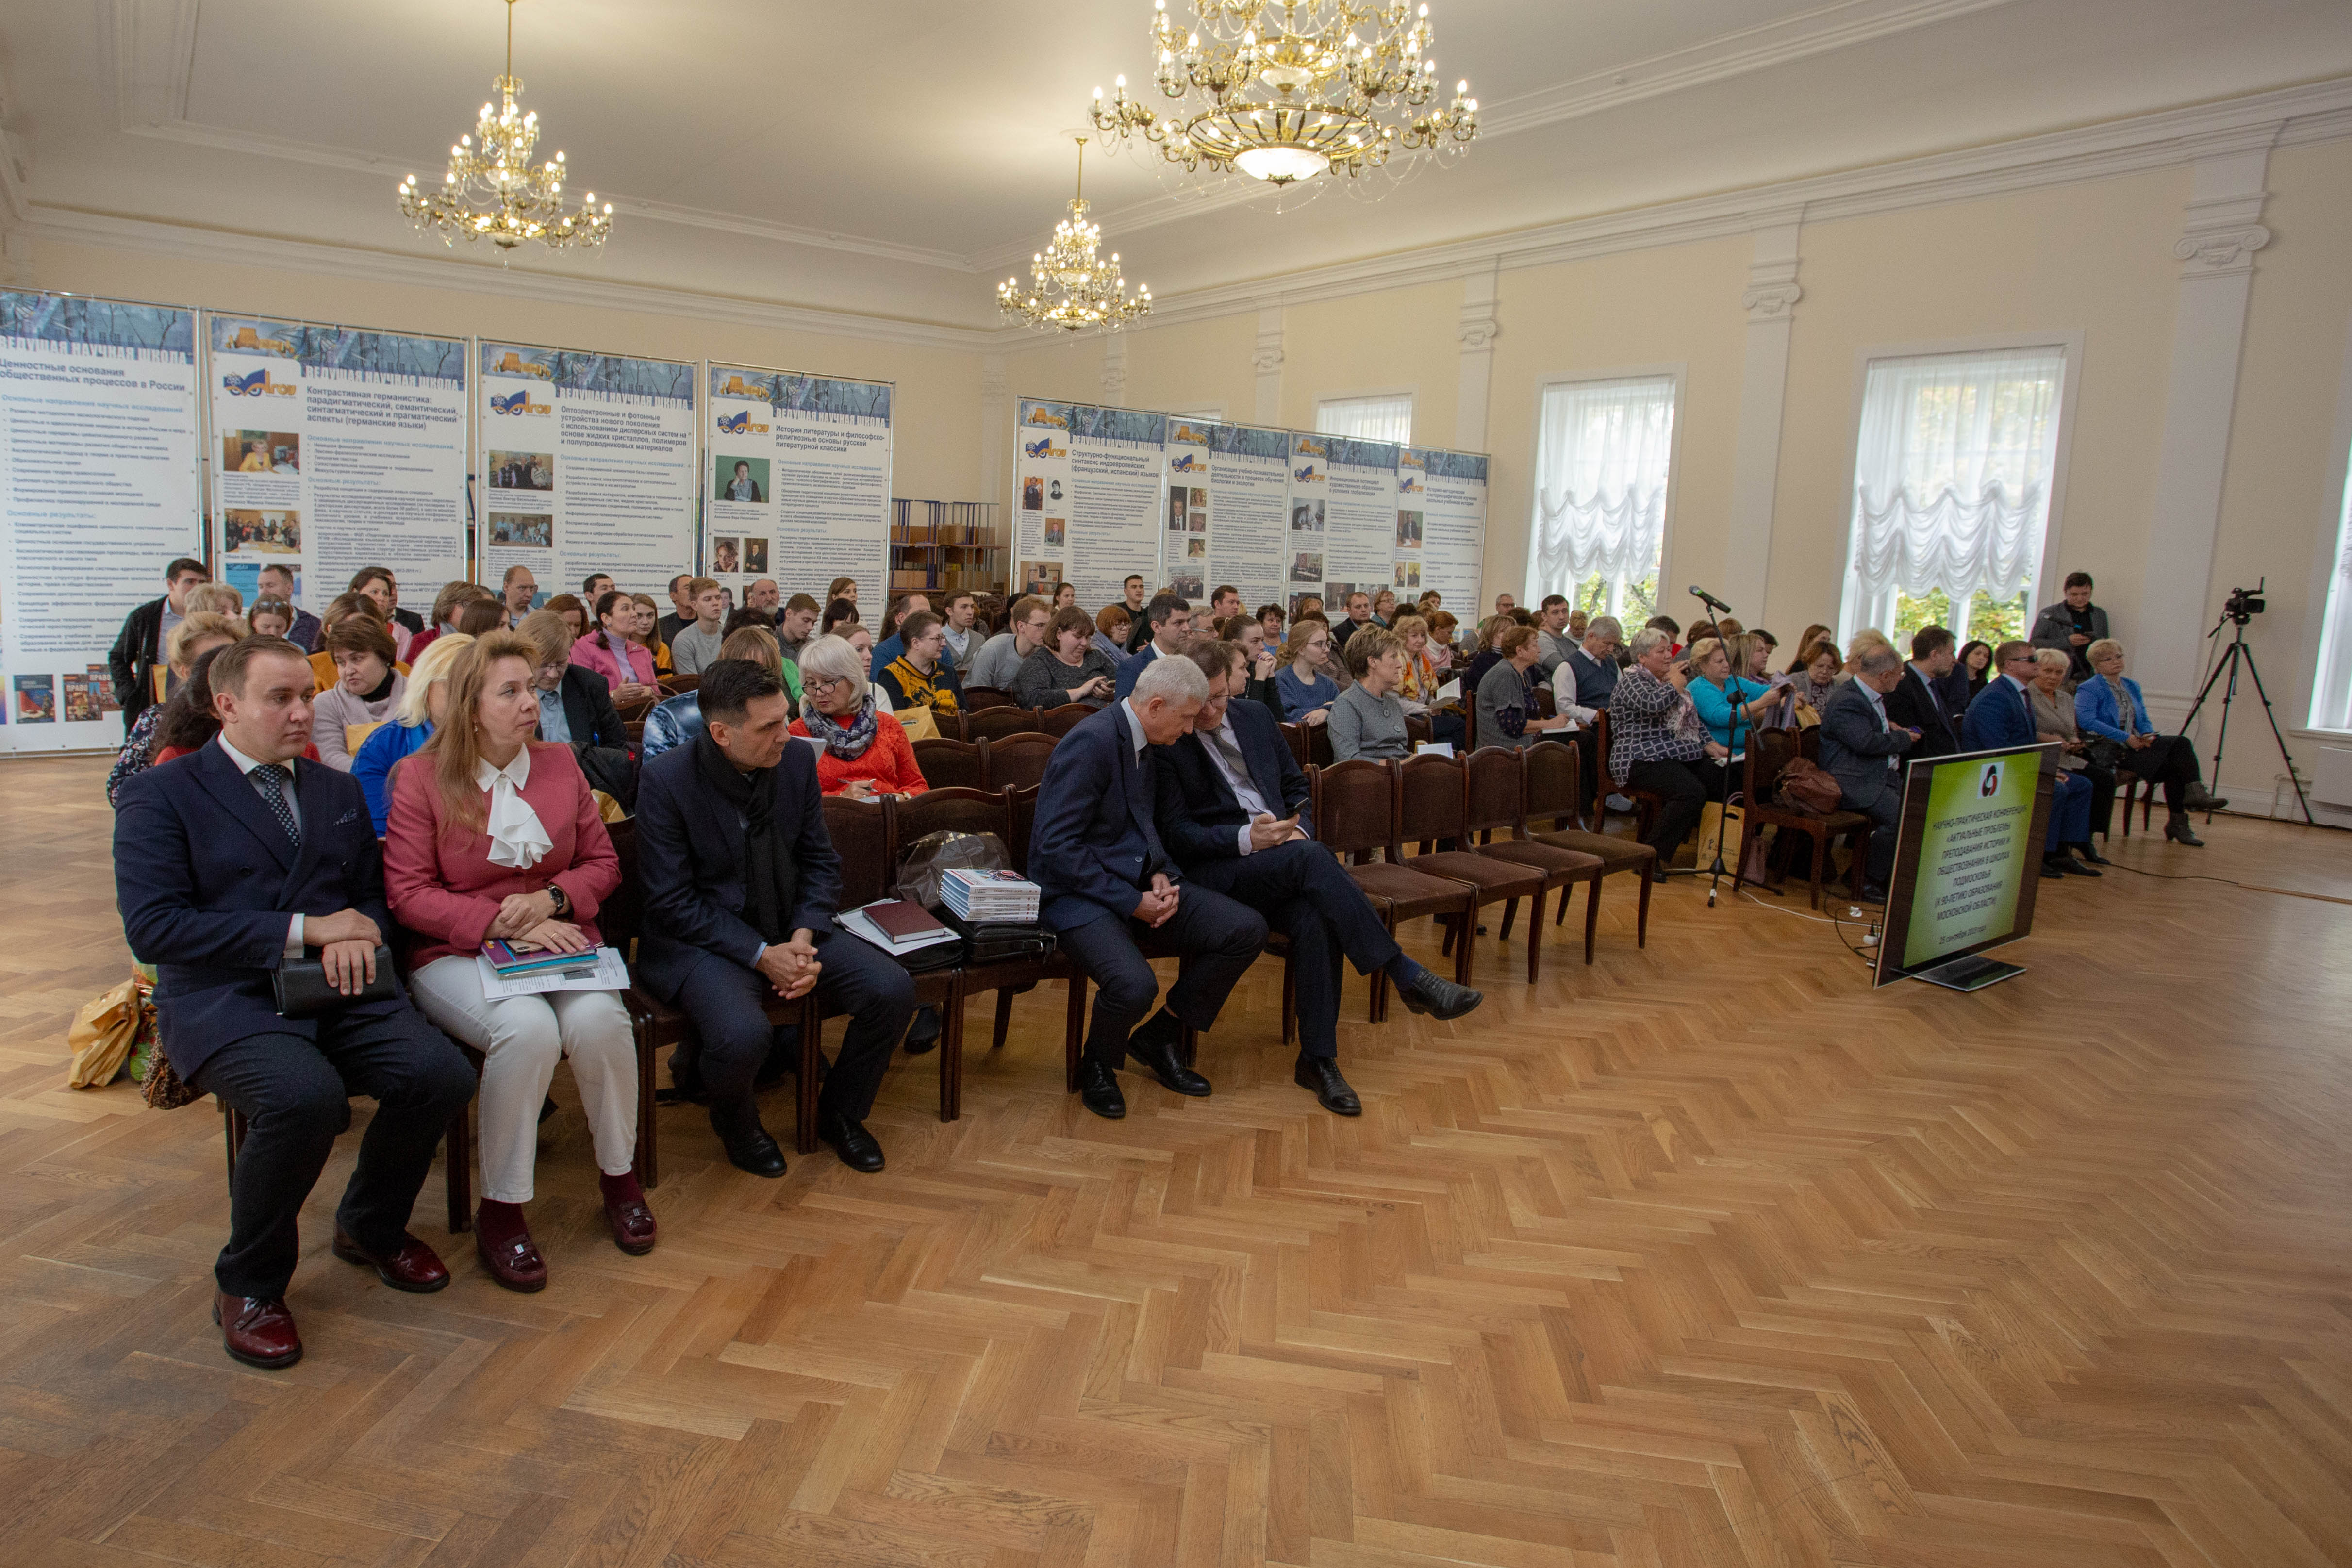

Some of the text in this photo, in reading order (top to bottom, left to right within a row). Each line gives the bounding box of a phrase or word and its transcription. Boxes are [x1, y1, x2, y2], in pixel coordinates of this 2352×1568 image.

[72, 342, 135, 360] НАУЧНАЯ
[137, 347, 186, 365] ШКОЛА
[0, 360, 125, 377] Ценностные основания
[0, 371, 80, 383] общественных
[83, 377, 138, 388] процессов
[149, 380, 185, 392] России
[306, 365, 458, 391] ВЕДУЩАЯ НАУЧНАЯ ШКОЛА
[307, 386, 371, 399] Контрастивная
[374, 393, 431, 404] германистика:
[559, 387, 688, 410] ВЕДУЩАЯ НАУЧНАЯ ШКОЛА
[307, 396, 393, 410] парадигматический,
[395, 404, 458, 414] семантический,
[561, 406, 620, 417] Оптоэлектронные
[627, 413, 660, 421] фотонные
[307, 406, 384, 417] синтагматический
[393, 413, 457, 423] прагматический
[307, 414, 426, 430] аспекты (германские языки)
[561, 415, 599, 424] устройства
[626, 420, 660, 429] поколения
[776, 408, 885, 428] ВЕДУЩАЯ НАУЧНАЯ ШКОЛА
[566, 423, 618, 433] использованием
[619, 428, 656, 436] дисперсных
[776, 425, 802, 434] История
[803, 429, 839, 438] литературы
[845, 432, 885, 441] философско-
[566, 439, 634, 449] полупроводниковых
[636, 444, 673, 452] материалов
[612, 434, 650, 443] кристаллов,
[652, 438, 687, 446] полимеров
[776, 434, 817, 443] религиозные
[776, 442, 819, 451] литературной
[1072, 450, 1149, 462] Структурно-функциональный
[1100, 461, 1145, 469] индоевропейских
[1238, 469, 1284, 478] учебно-познавательной
[1947, 822, 2010, 843] «АКТУАЛЬНЫЕ ПРОБЛЕМЫ
[1942, 842, 1983, 859] ПРЕПОДАВАНИЯ
[1983, 838, 2005, 849] ИСТОРИИ
[1937, 857, 1985, 876] ОБЩЕСТВОЗНАНИЯ
[1989, 851, 2010, 863] ШКОЛАХ
[1953, 870, 1991, 887] ПОДМОСКОВЬЯ
[1941, 890, 1967, 906] 90-ЛЕТИЮ
[1968, 881, 2003, 897] ОБРАЗОВАНИЯ
[1937, 897, 1997, 921] МОСКОВСКОЙ ОБЛАСТИ)
